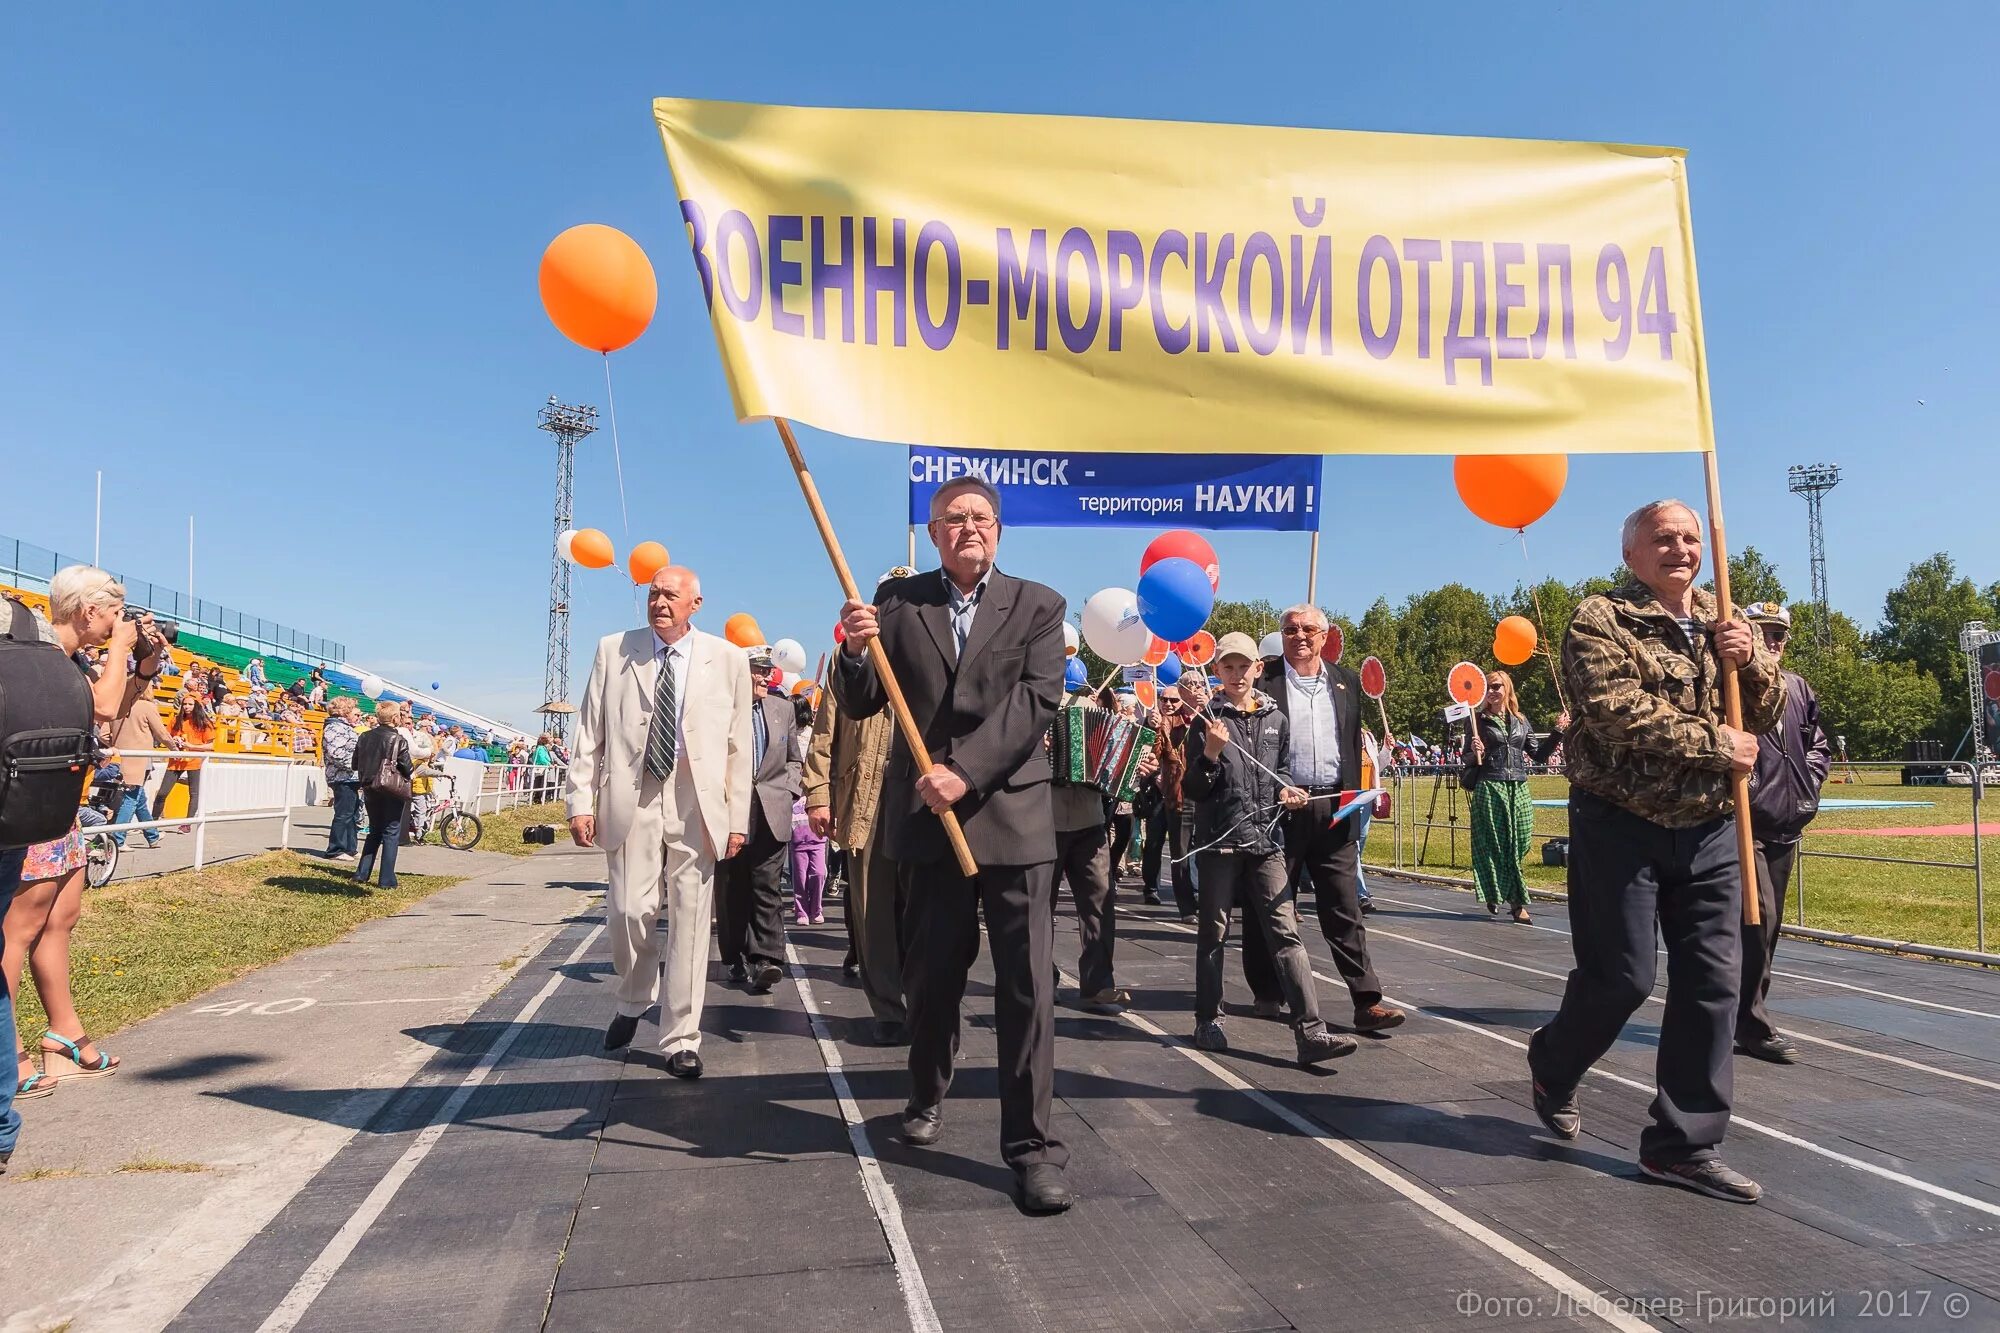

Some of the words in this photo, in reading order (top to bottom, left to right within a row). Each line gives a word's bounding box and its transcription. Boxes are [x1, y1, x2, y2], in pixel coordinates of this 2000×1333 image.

[1357, 234, 1578, 386] ОТДЕЛ
[1596, 243, 1677, 362] 94
[909, 455, 1069, 486] СНЕЖИНСК
[1079, 494, 1183, 515] территория
[1195, 484, 1295, 513] НАУКИ
[186, 997, 318, 1016] 40
